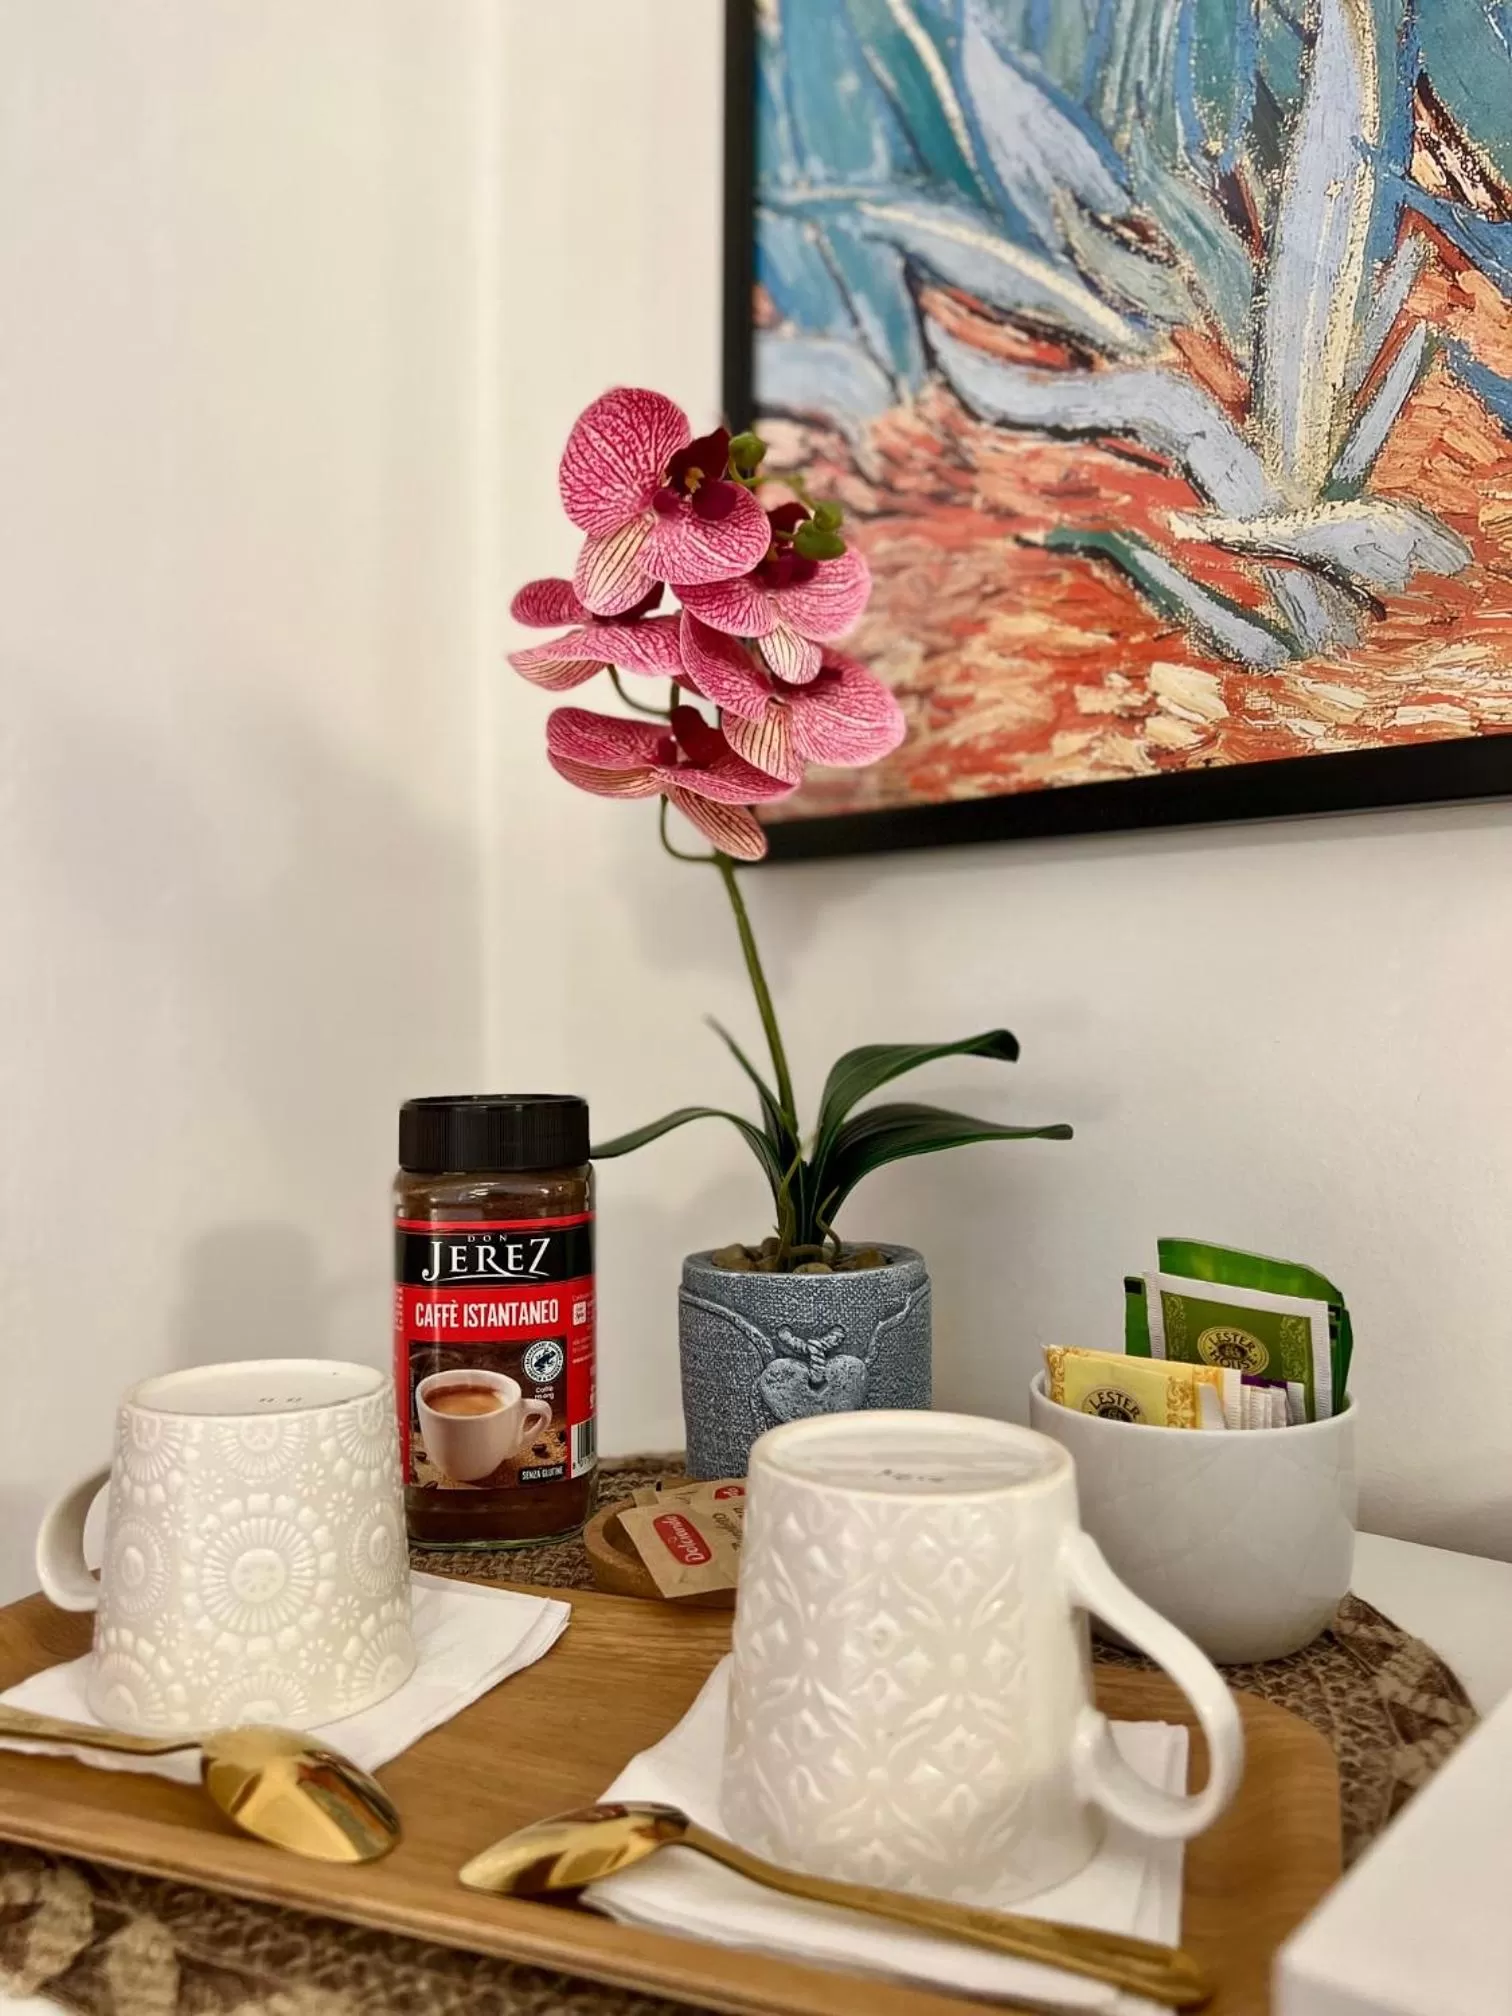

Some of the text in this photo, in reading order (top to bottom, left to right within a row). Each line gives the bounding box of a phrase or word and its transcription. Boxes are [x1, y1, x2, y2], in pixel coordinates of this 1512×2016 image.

[467, 1234, 508, 1243] DON
[421, 1236, 551, 1282] JEREZ
[415, 1299, 459, 1328] CAFFÈ
[463, 1298, 559, 1328] ISTANTANEO
[1209, 1332, 1256, 1352] LESTER
[1209, 1350, 1257, 1369] HOUSE
[1089, 1391, 1141, 1419] LESTER
[522, 1469, 541, 1481] SENZA
